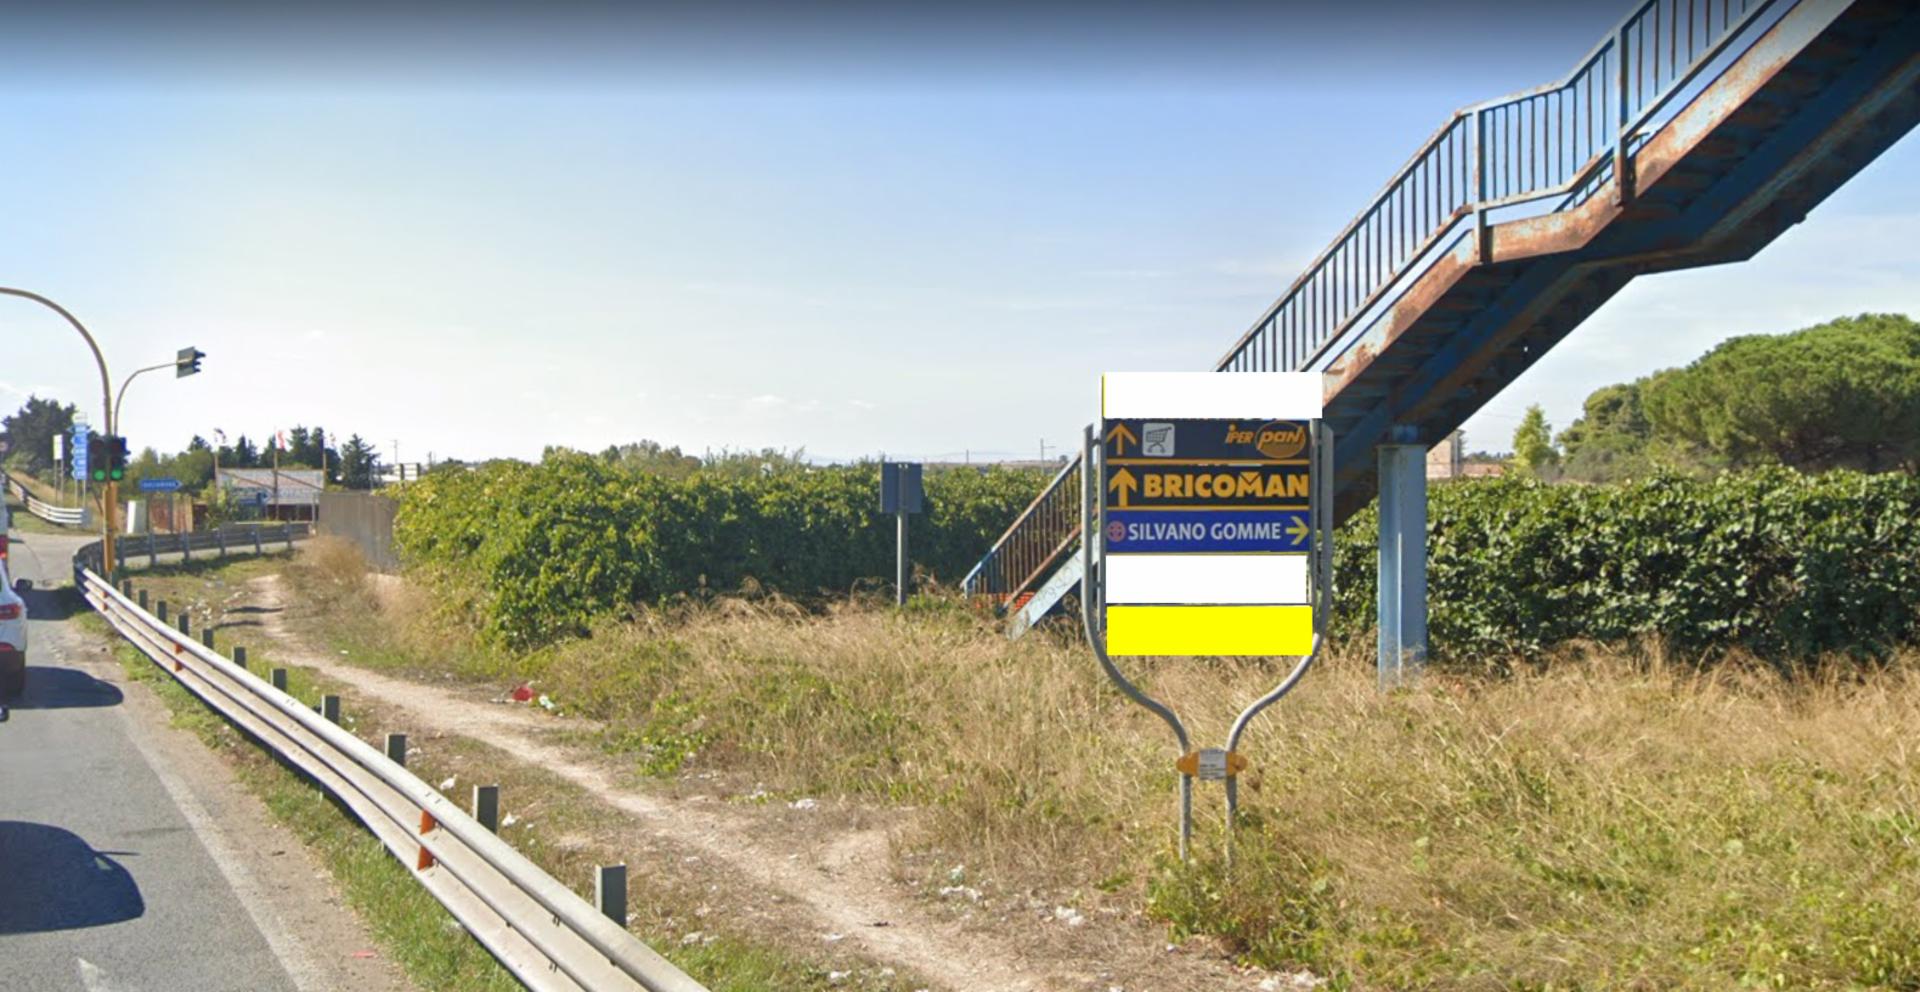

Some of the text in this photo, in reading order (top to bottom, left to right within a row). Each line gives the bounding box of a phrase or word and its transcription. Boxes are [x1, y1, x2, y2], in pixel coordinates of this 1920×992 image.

[1144, 471, 1309, 497] BRICOMAN
[1128, 523, 1281, 540] SILVANO GOMME
